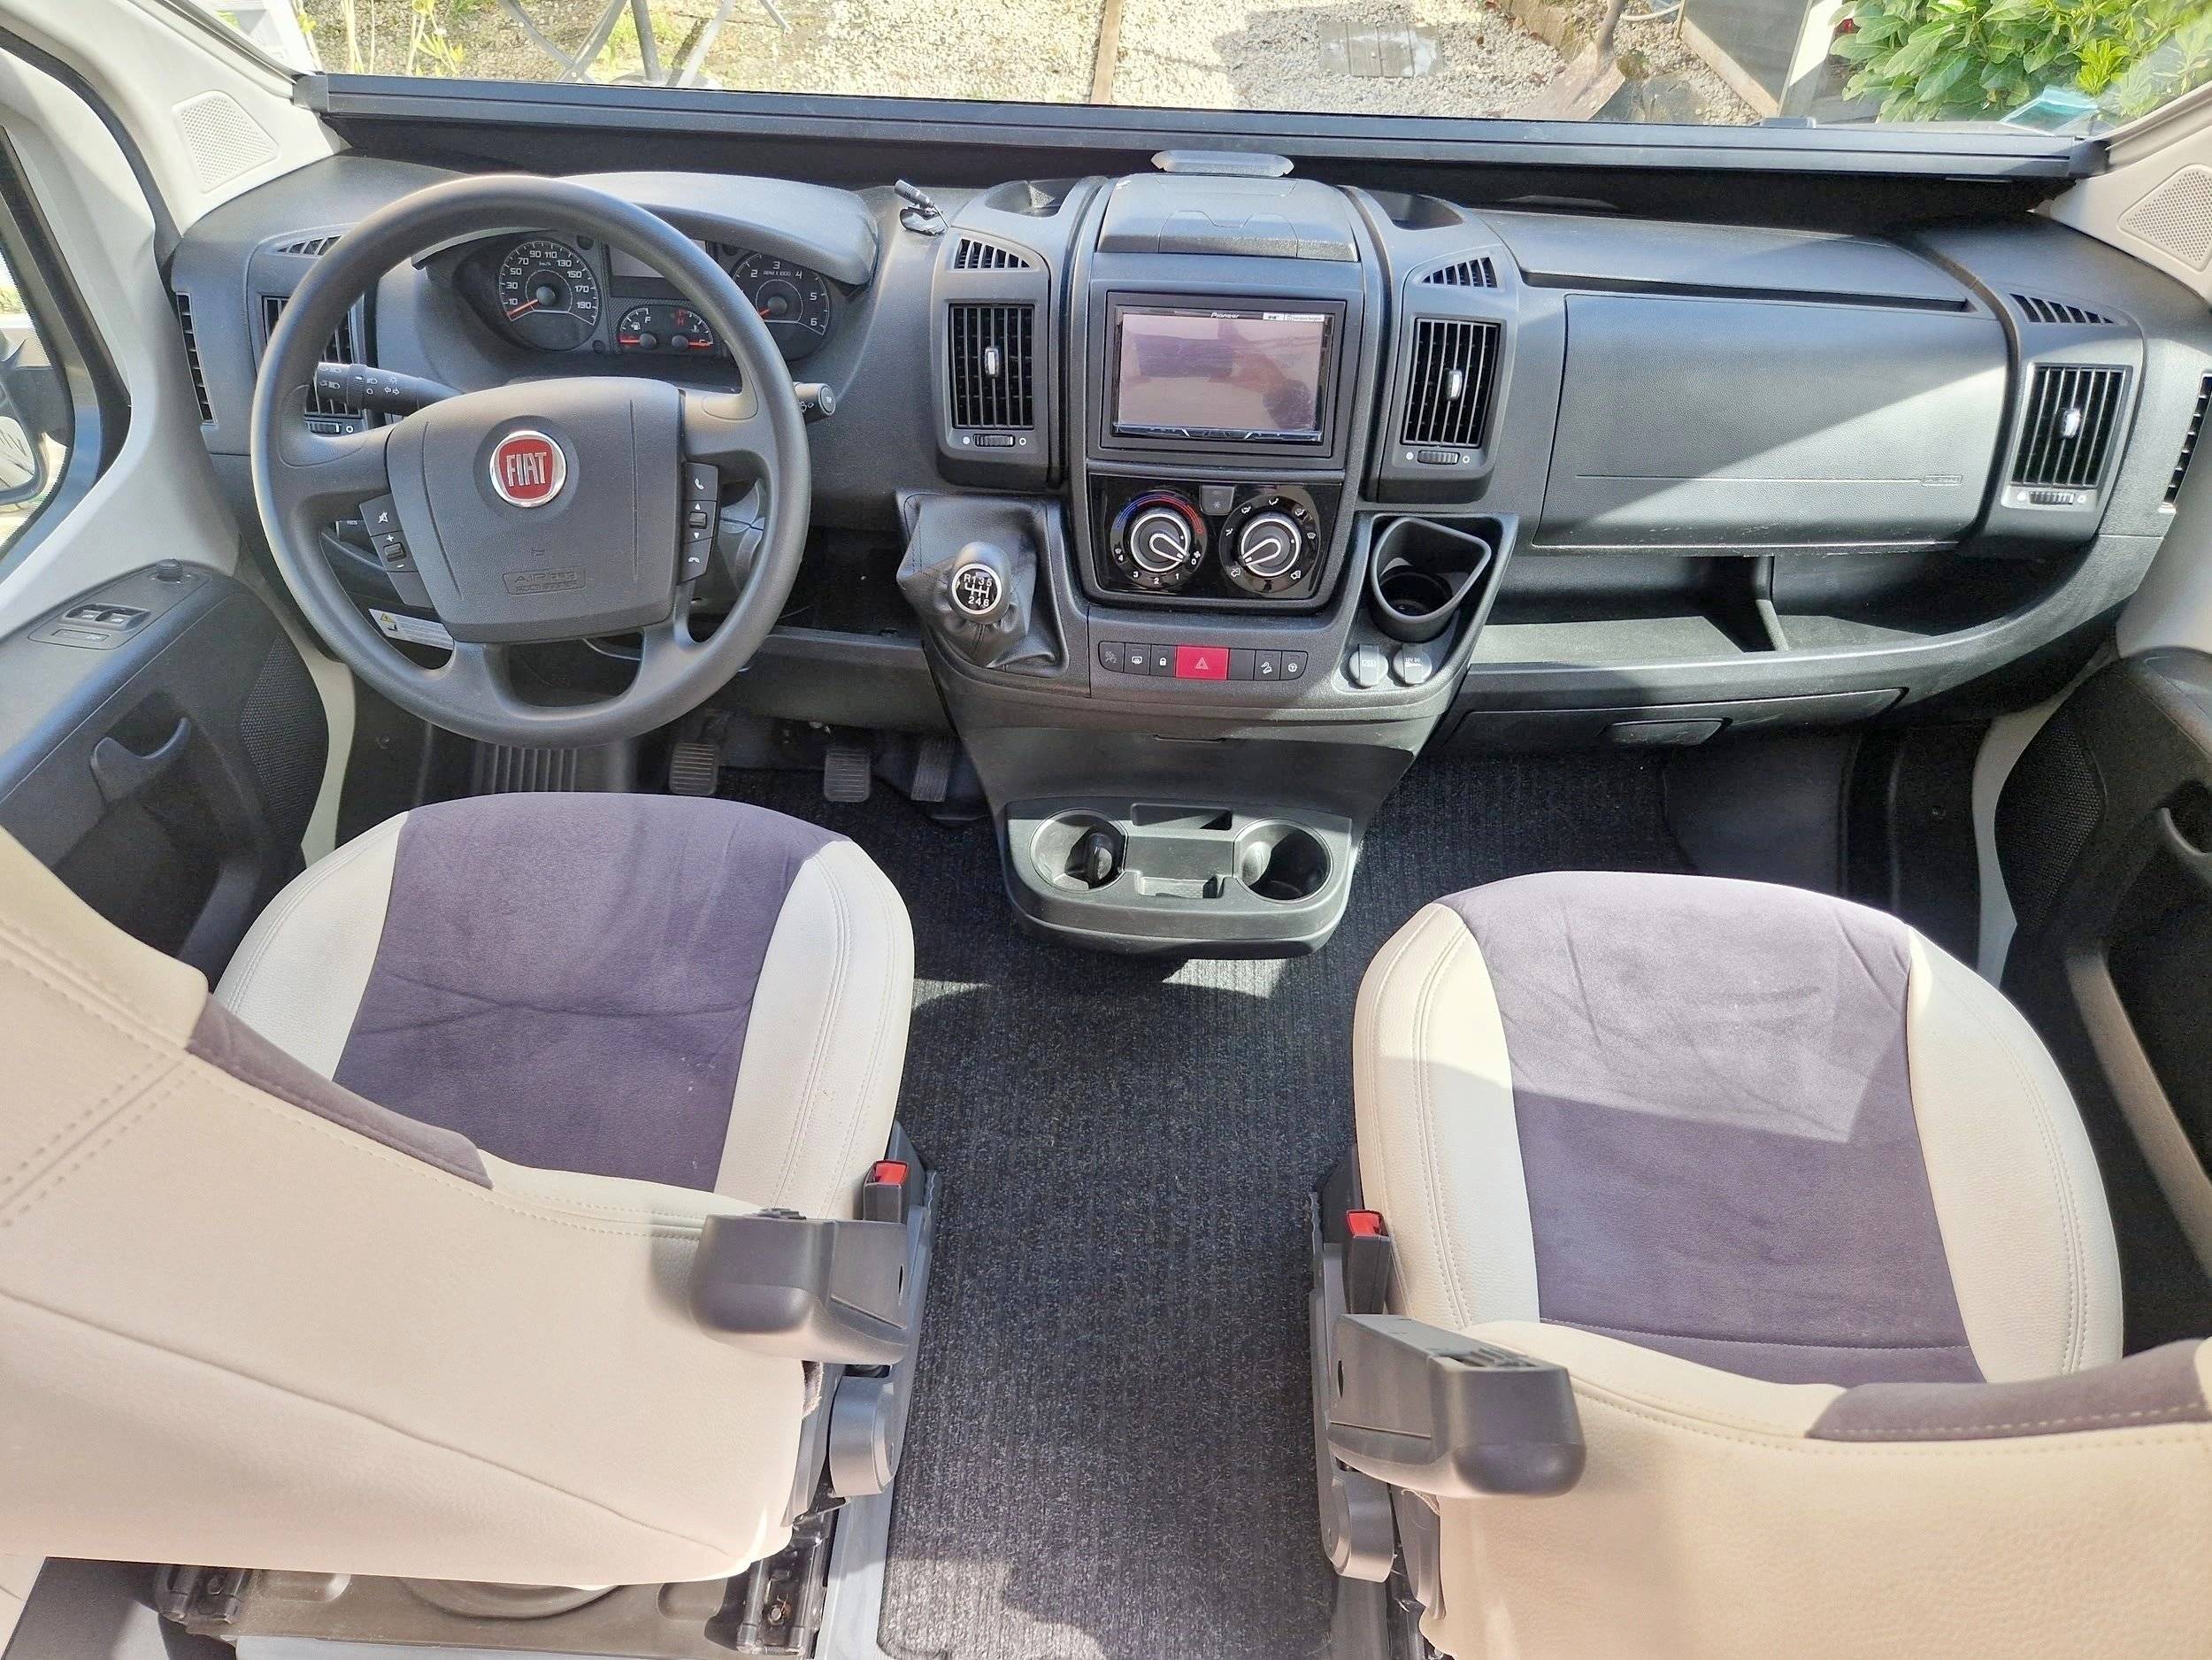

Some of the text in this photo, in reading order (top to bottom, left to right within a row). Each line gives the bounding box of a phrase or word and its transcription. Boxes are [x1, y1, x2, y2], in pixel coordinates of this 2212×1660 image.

[750, 269, 758, 278] 2
[795, 270, 803, 279] 4
[810, 292, 818, 301] 5
[506, 451, 547, 487] FIAT
[964, 573, 972, 583] R
[987, 578, 992, 587] 5
[968, 596, 989, 607] 2 4 6
